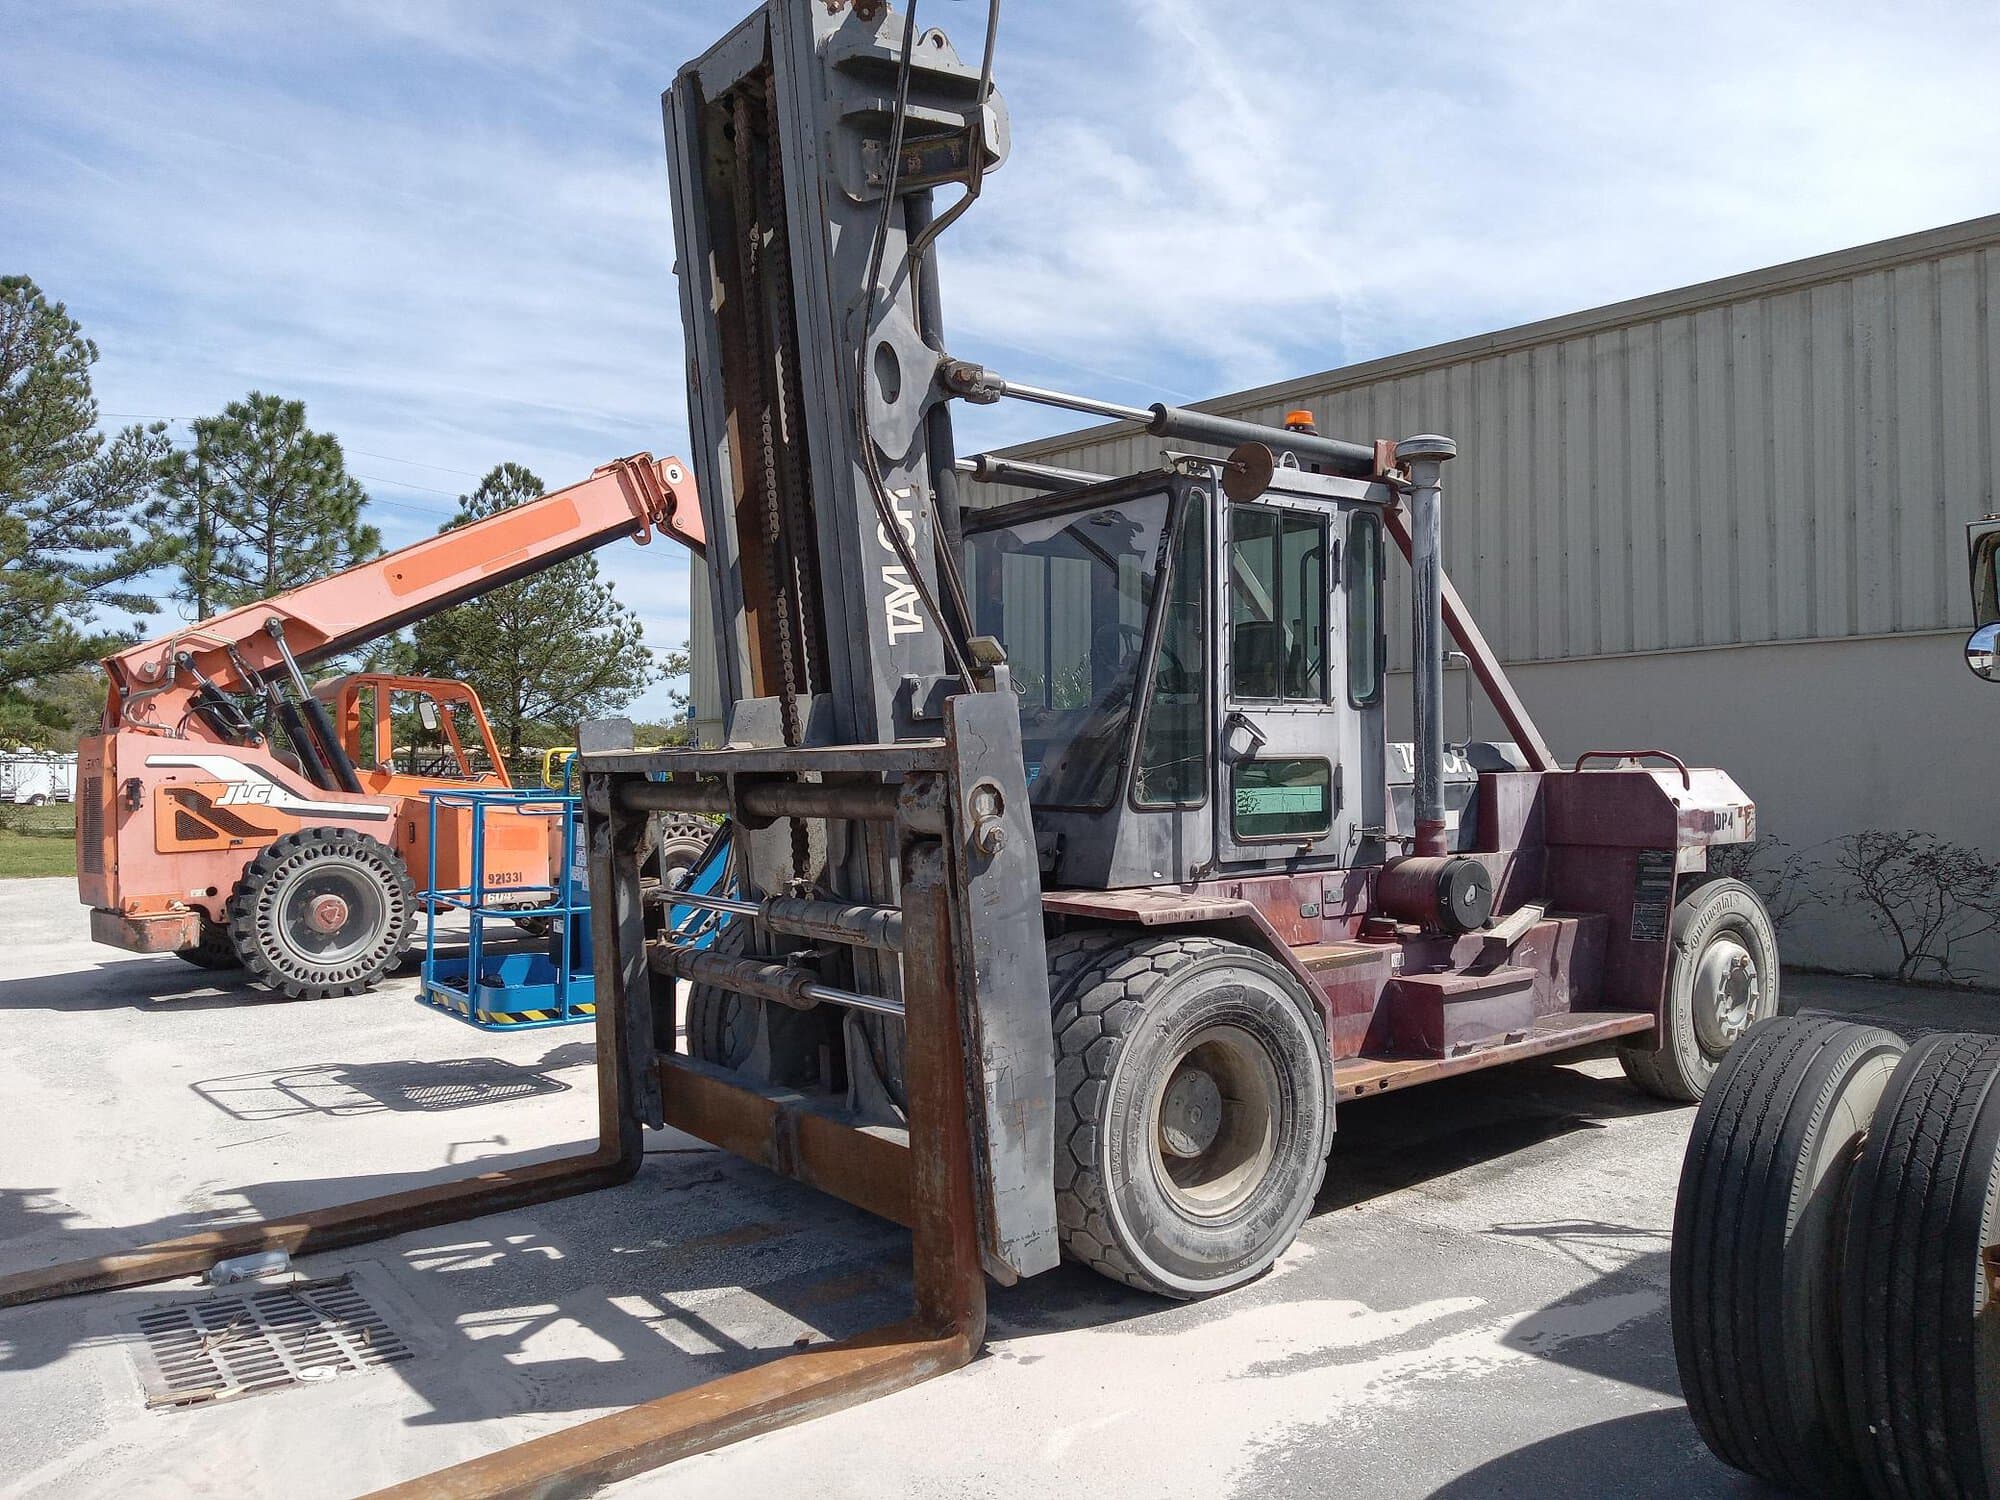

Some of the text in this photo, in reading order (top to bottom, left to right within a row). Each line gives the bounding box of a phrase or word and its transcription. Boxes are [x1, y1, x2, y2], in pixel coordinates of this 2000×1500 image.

[670, 469, 678, 480] 6
[215, 784, 273, 806] JLG
[488, 871, 523, 885] 921331
